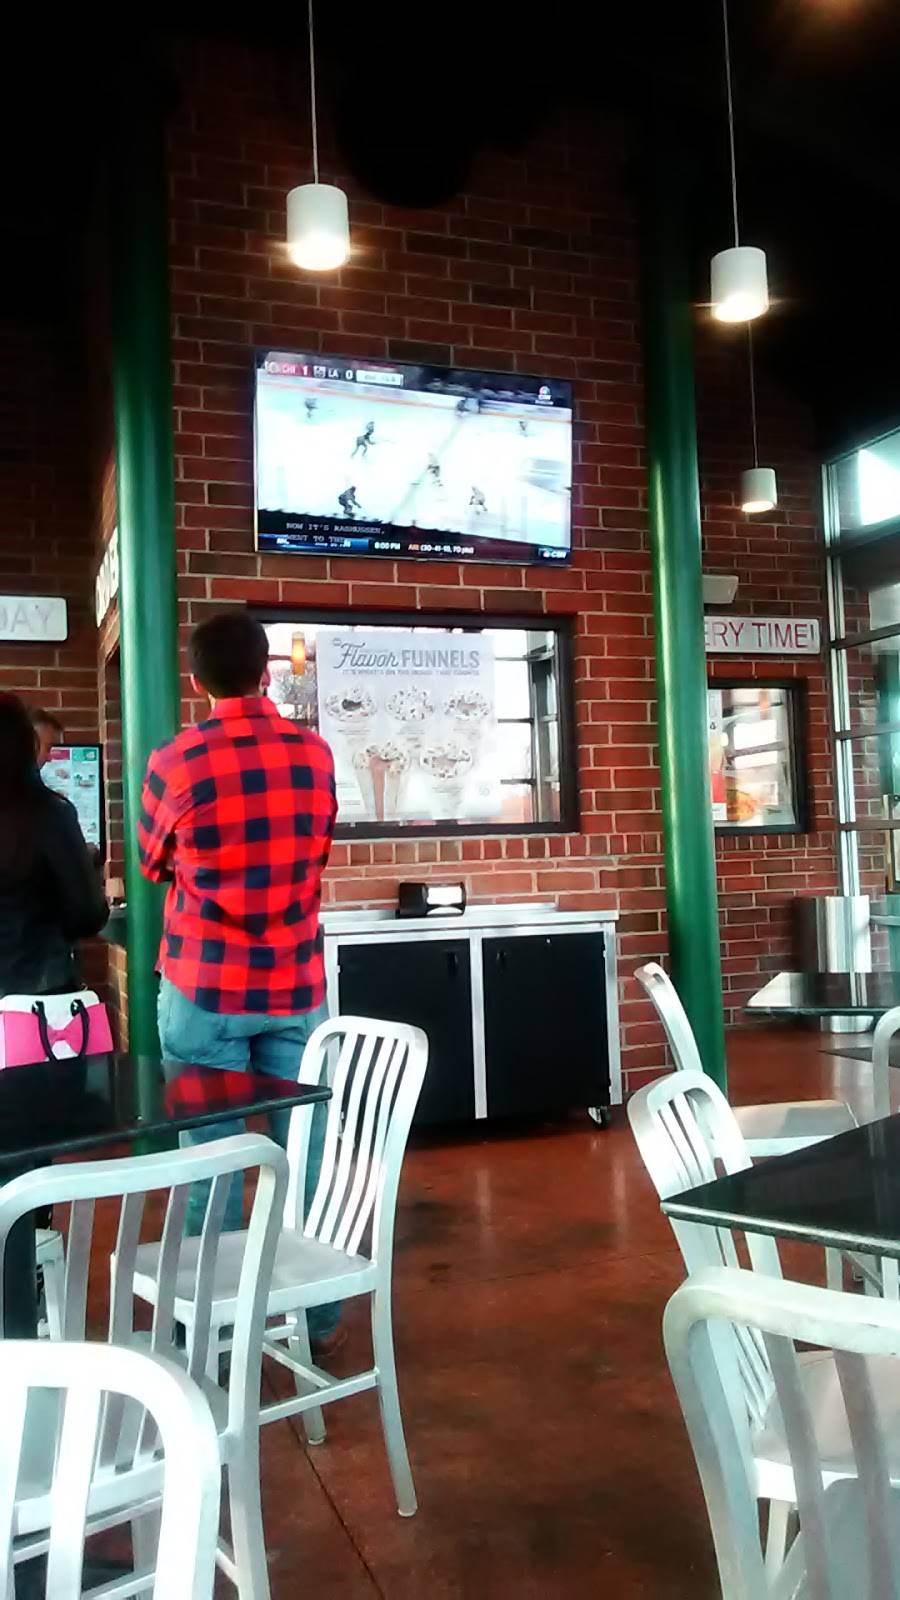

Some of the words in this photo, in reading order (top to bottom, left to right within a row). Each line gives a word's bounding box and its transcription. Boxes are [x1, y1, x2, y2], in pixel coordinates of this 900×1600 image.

[302, 366, 308, 376] 1
[328, 368, 339, 378] LA
[346, 369, 353, 380] 0
[286, 522, 303, 531] NOW
[751, 622, 815, 649] TIME!
[333, 642, 399, 669] Flavor
[401, 649, 480, 669] FUNNELS
